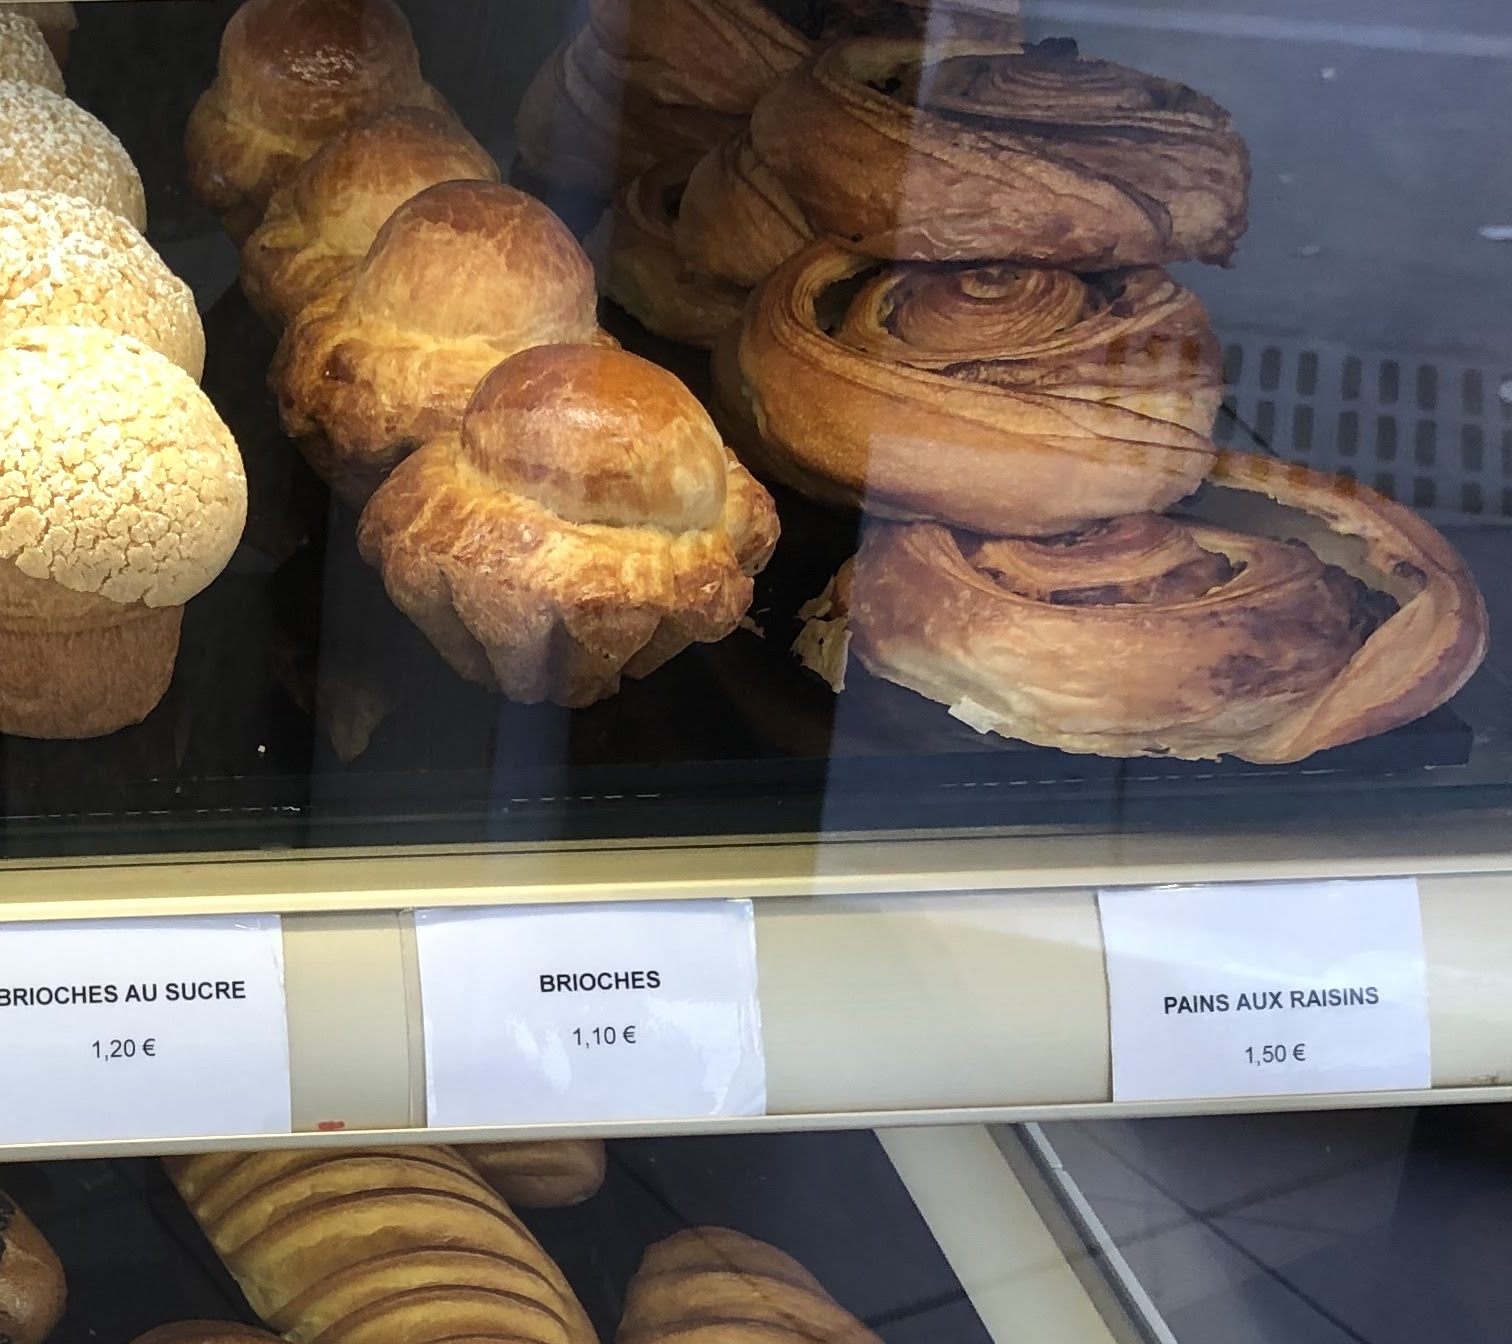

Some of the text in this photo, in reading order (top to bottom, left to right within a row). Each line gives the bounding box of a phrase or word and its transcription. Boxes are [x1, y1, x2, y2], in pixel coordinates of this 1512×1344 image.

[124, 983, 158, 1003] AU
[165, 980, 247, 1002] SUCRE
[539, 970, 661, 993] BRIOCHES
[1163, 986, 1380, 1015] PAINS AUX RAISINS
[572, 1025, 637, 1049] 1,10 €
[91, 1037, 156, 1062] 1,20 €
[1244, 1042, 1306, 1067] 1,50 €
